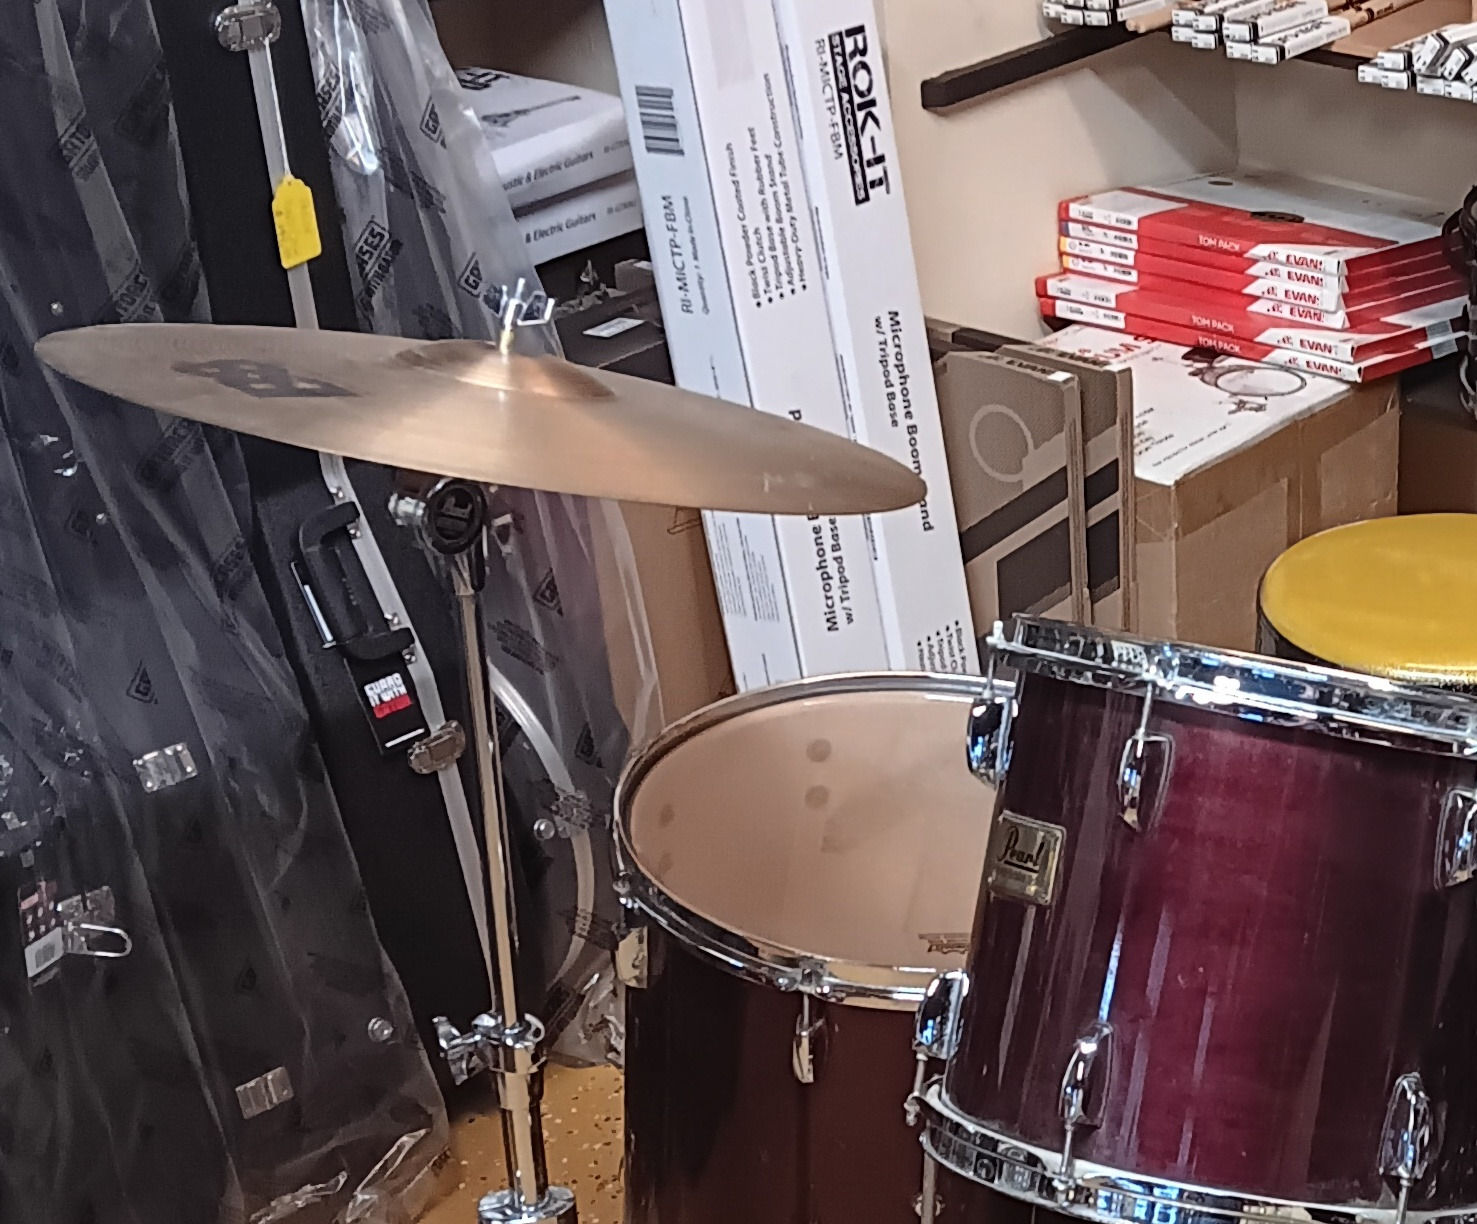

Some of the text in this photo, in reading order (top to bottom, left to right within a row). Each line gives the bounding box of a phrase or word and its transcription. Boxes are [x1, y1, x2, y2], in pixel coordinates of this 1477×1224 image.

[831, 33, 848, 89] STAGE
[845, 24, 890, 195] ROK-IT
[1198, 235, 1241, 251] TOM PACK
[1212, 319, 1235, 332] PACK
[1217, 340, 1241, 353] PACK
[1299, 339, 1332, 354] EVAN
[878, 337, 894, 389] Tripod
[886, 391, 899, 428] Base
[888, 310, 913, 420] Microphone
[907, 424, 921, 475] Boom
[828, 518, 841, 552] Base
[813, 525, 839, 632] Microphone
[834, 554, 851, 602] Tripod
[998, 826, 1045, 870] Pearl
